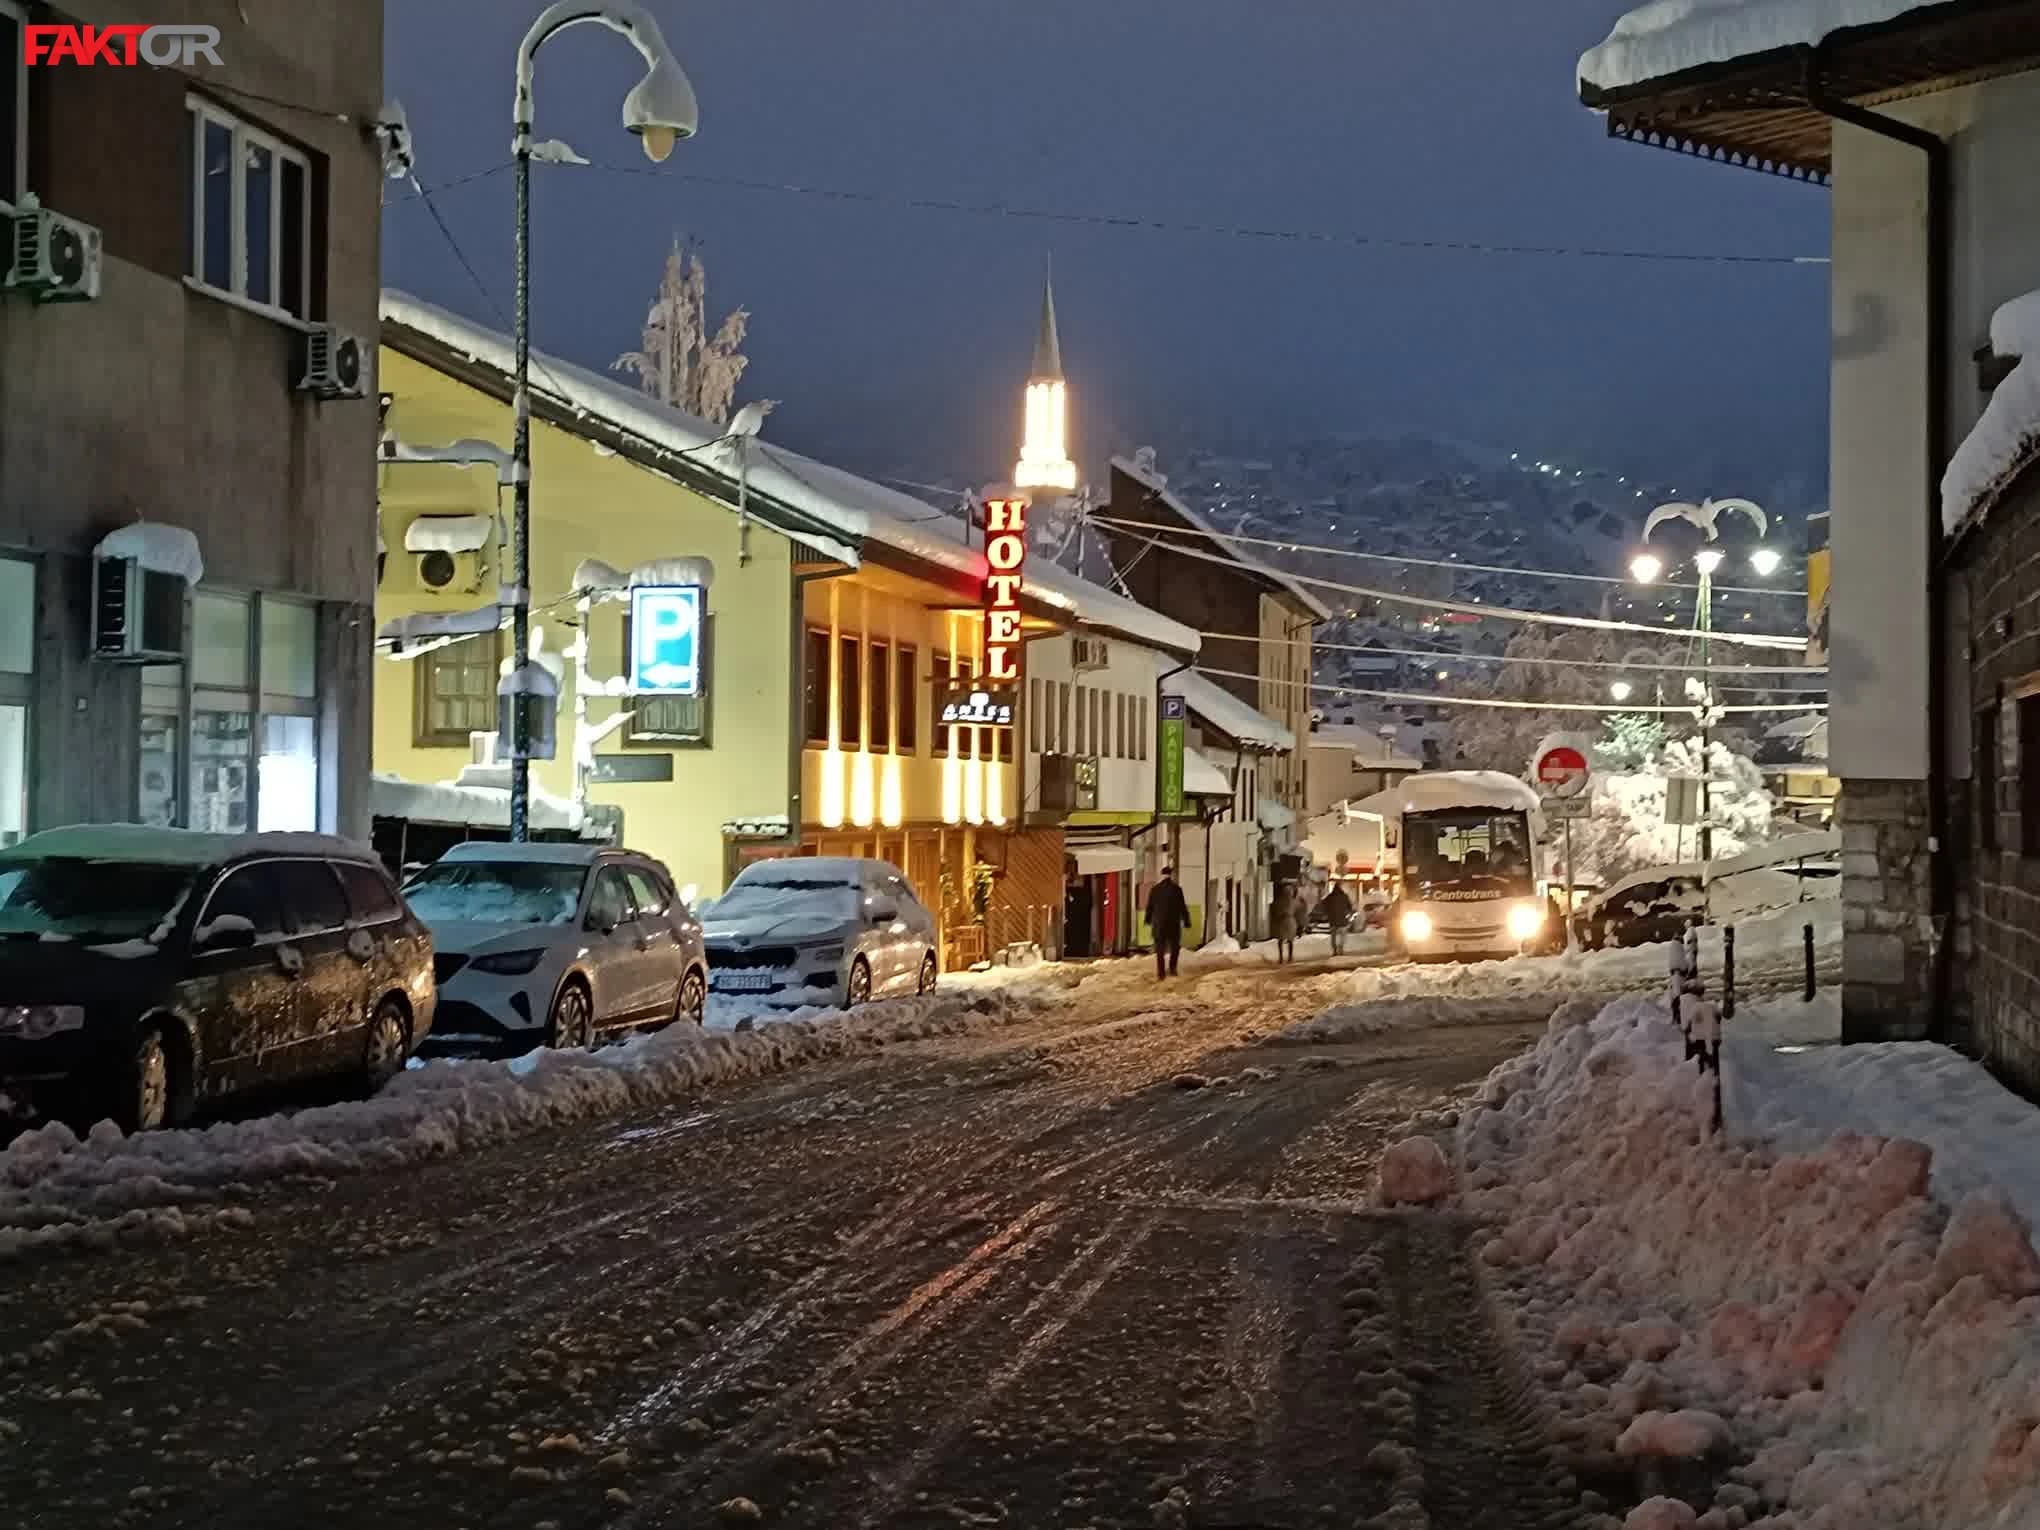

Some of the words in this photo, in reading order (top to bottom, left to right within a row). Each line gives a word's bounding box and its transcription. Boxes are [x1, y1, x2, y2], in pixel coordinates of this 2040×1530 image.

[987, 500, 1025, 679] HOTEL
[639, 594, 695, 664] P
[1167, 701, 1179, 716] P
[1432, 888, 1501, 900] Centrotrans
